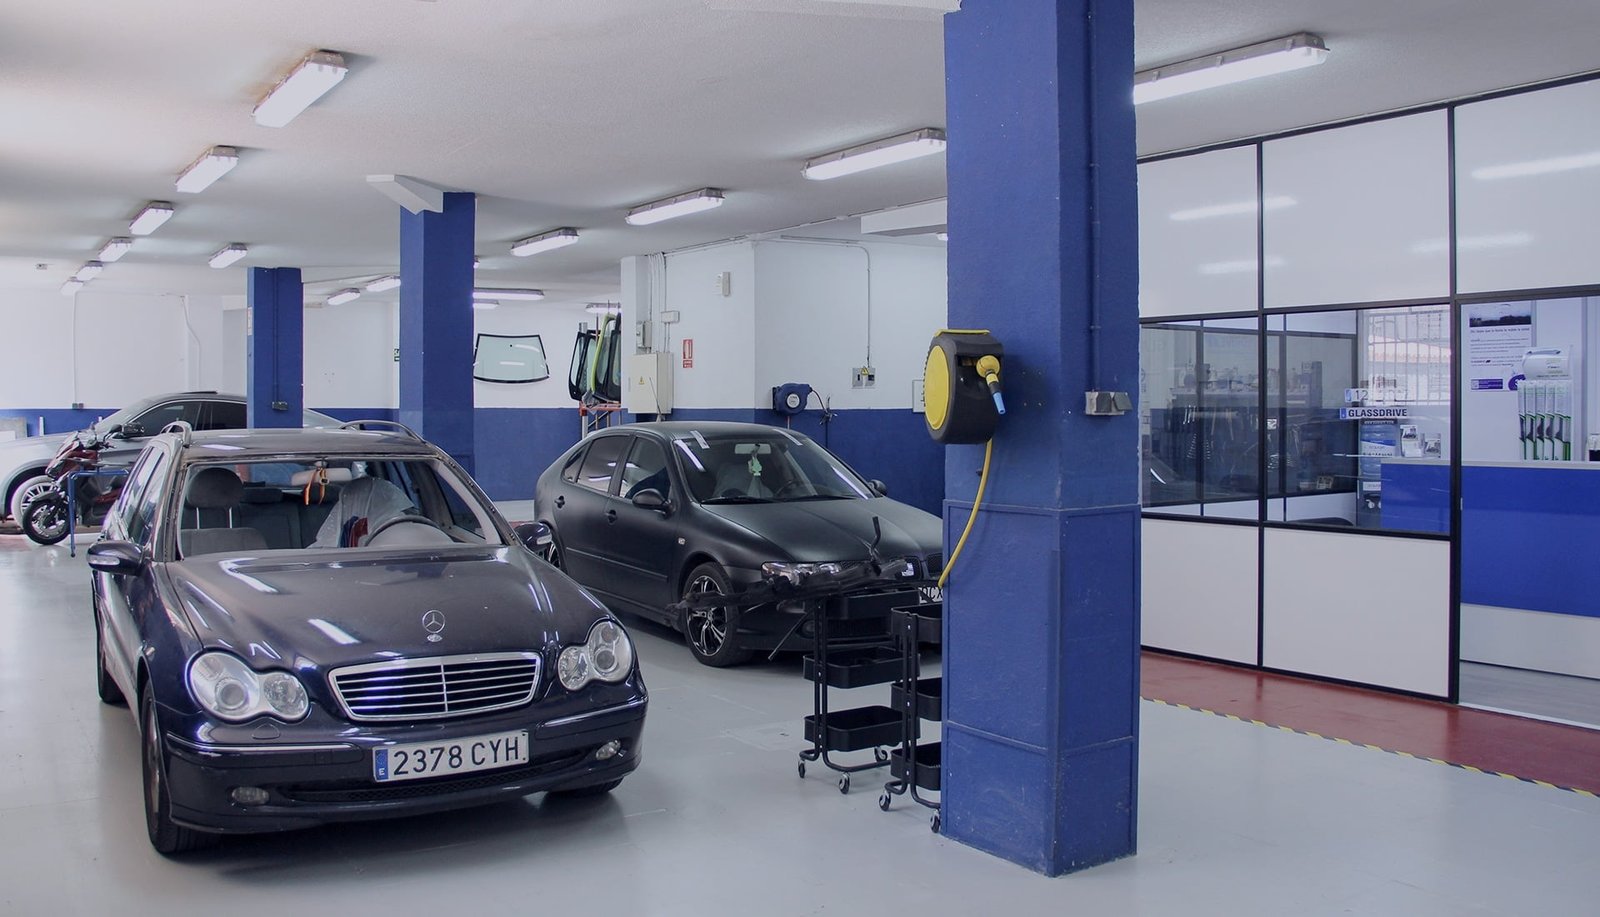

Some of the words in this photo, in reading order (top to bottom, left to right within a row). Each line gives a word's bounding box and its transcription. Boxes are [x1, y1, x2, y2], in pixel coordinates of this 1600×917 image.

[1348, 408, 1408, 418] GLASSDRIVE
[378, 768, 385, 776] E
[393, 745, 463, 776] 2378
[471, 736, 519, 766] CYH
